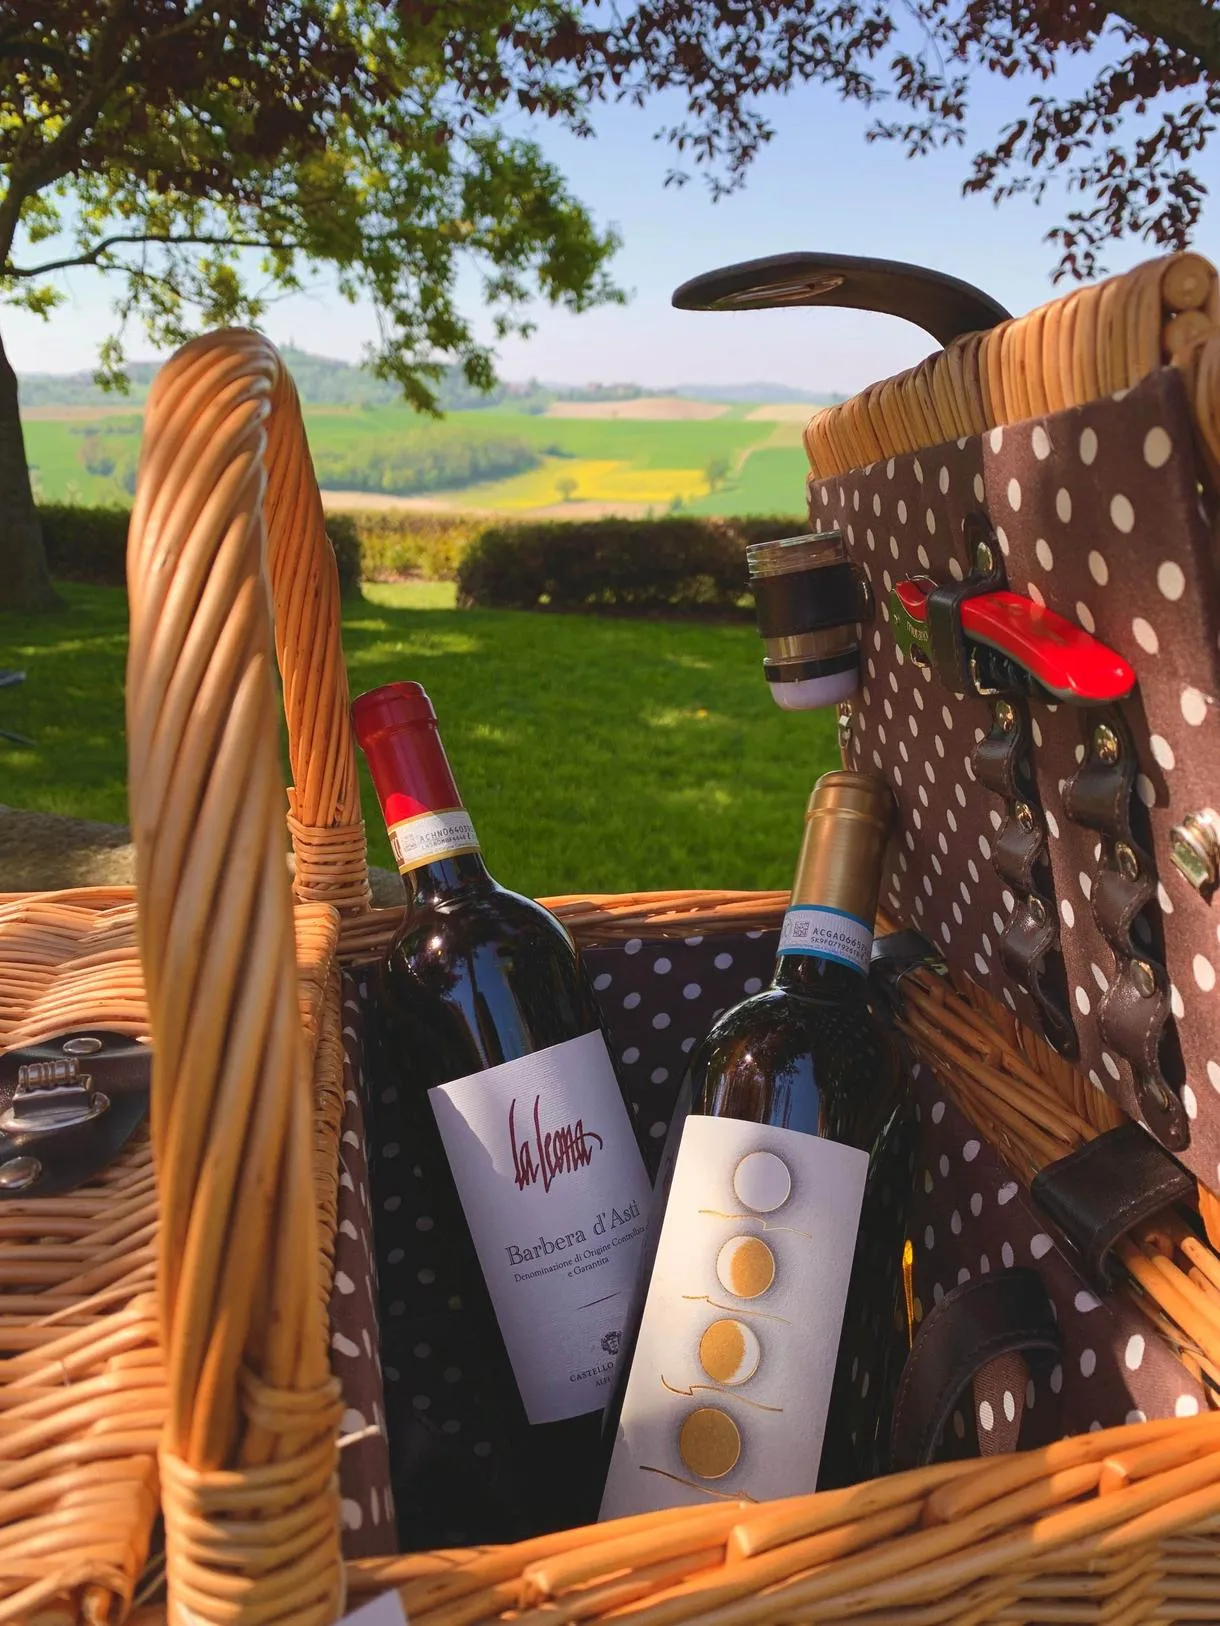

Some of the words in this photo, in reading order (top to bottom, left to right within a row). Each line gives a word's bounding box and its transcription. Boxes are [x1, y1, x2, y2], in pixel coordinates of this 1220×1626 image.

[505, 1230, 587, 1266] Barbera
[592, 1199, 641, 1237] d'Asti
[514, 1259, 575, 1282] Denominazione
[574, 1252, 583, 1264] di
[583, 1242, 611, 1261] Origine
[567, 1270, 574, 1278] e
[573, 1255, 609, 1276] Garantita
[570, 1361, 614, 1382] CASTELLO
